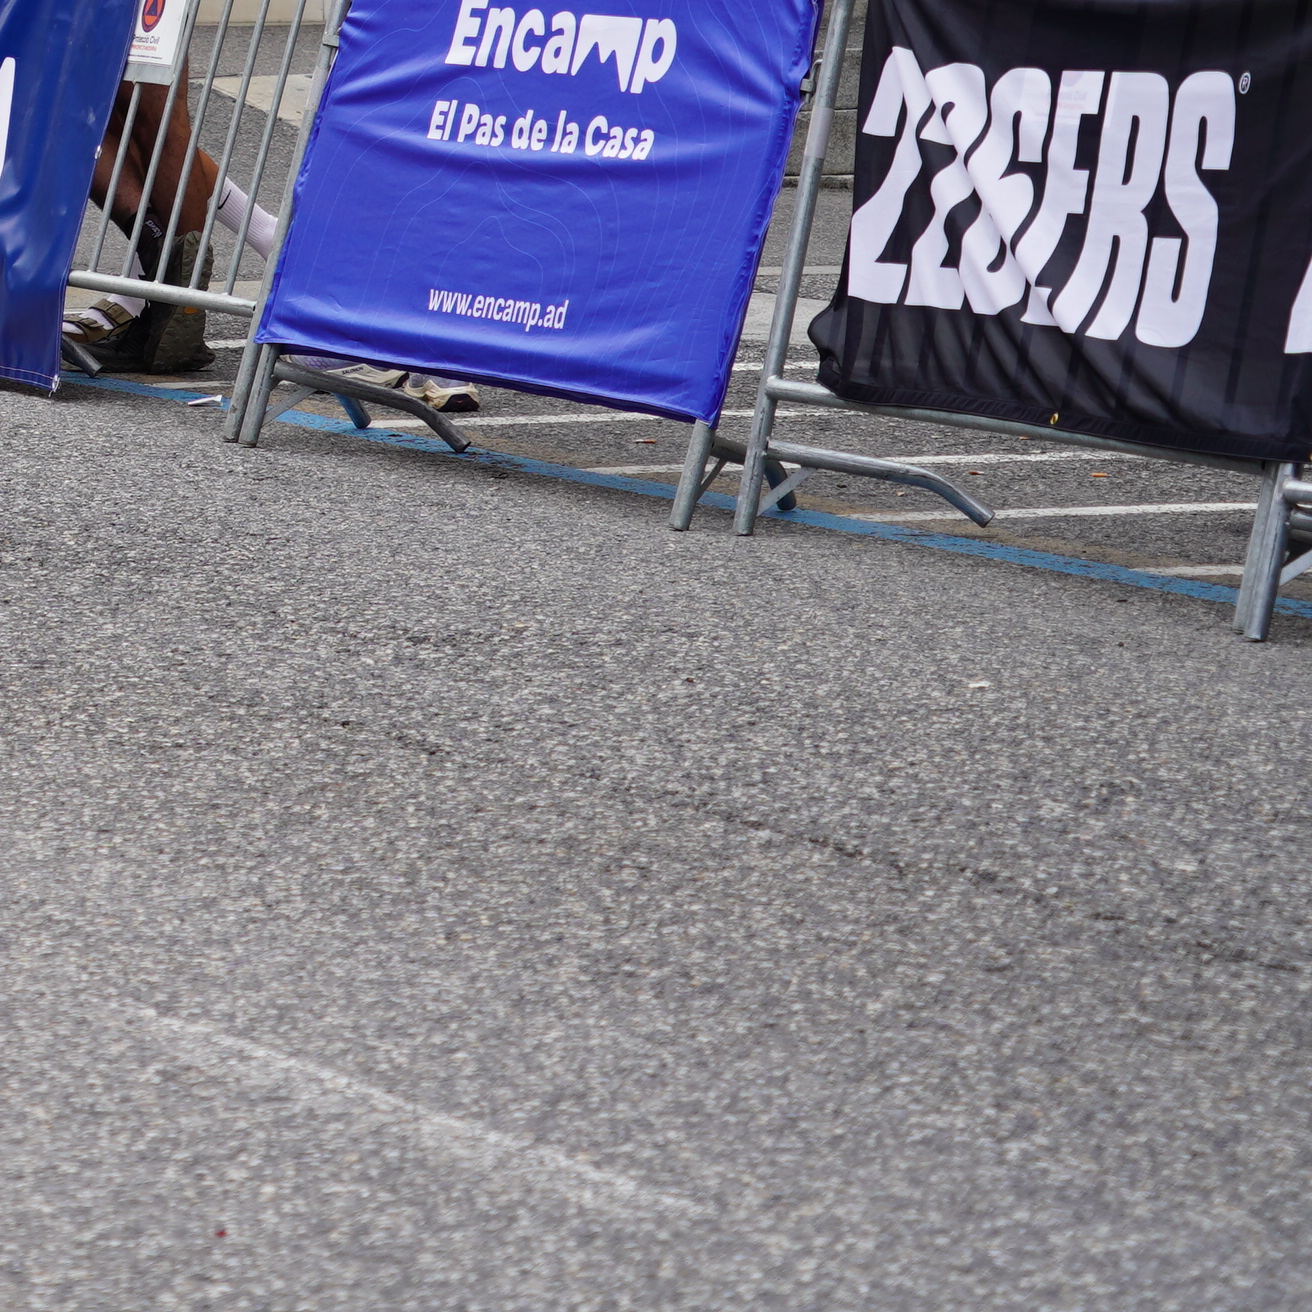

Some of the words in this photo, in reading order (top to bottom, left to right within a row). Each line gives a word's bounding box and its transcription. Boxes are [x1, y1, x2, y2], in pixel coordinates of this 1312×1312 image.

[427, 99, 458, 141] El
[457, 103, 505, 148] Pas
[511, 109, 548, 152] de
[550, 109, 579, 155] la
[584, 114, 655, 161] Casa
[427, 288, 570, 333] www.encamp.ad
